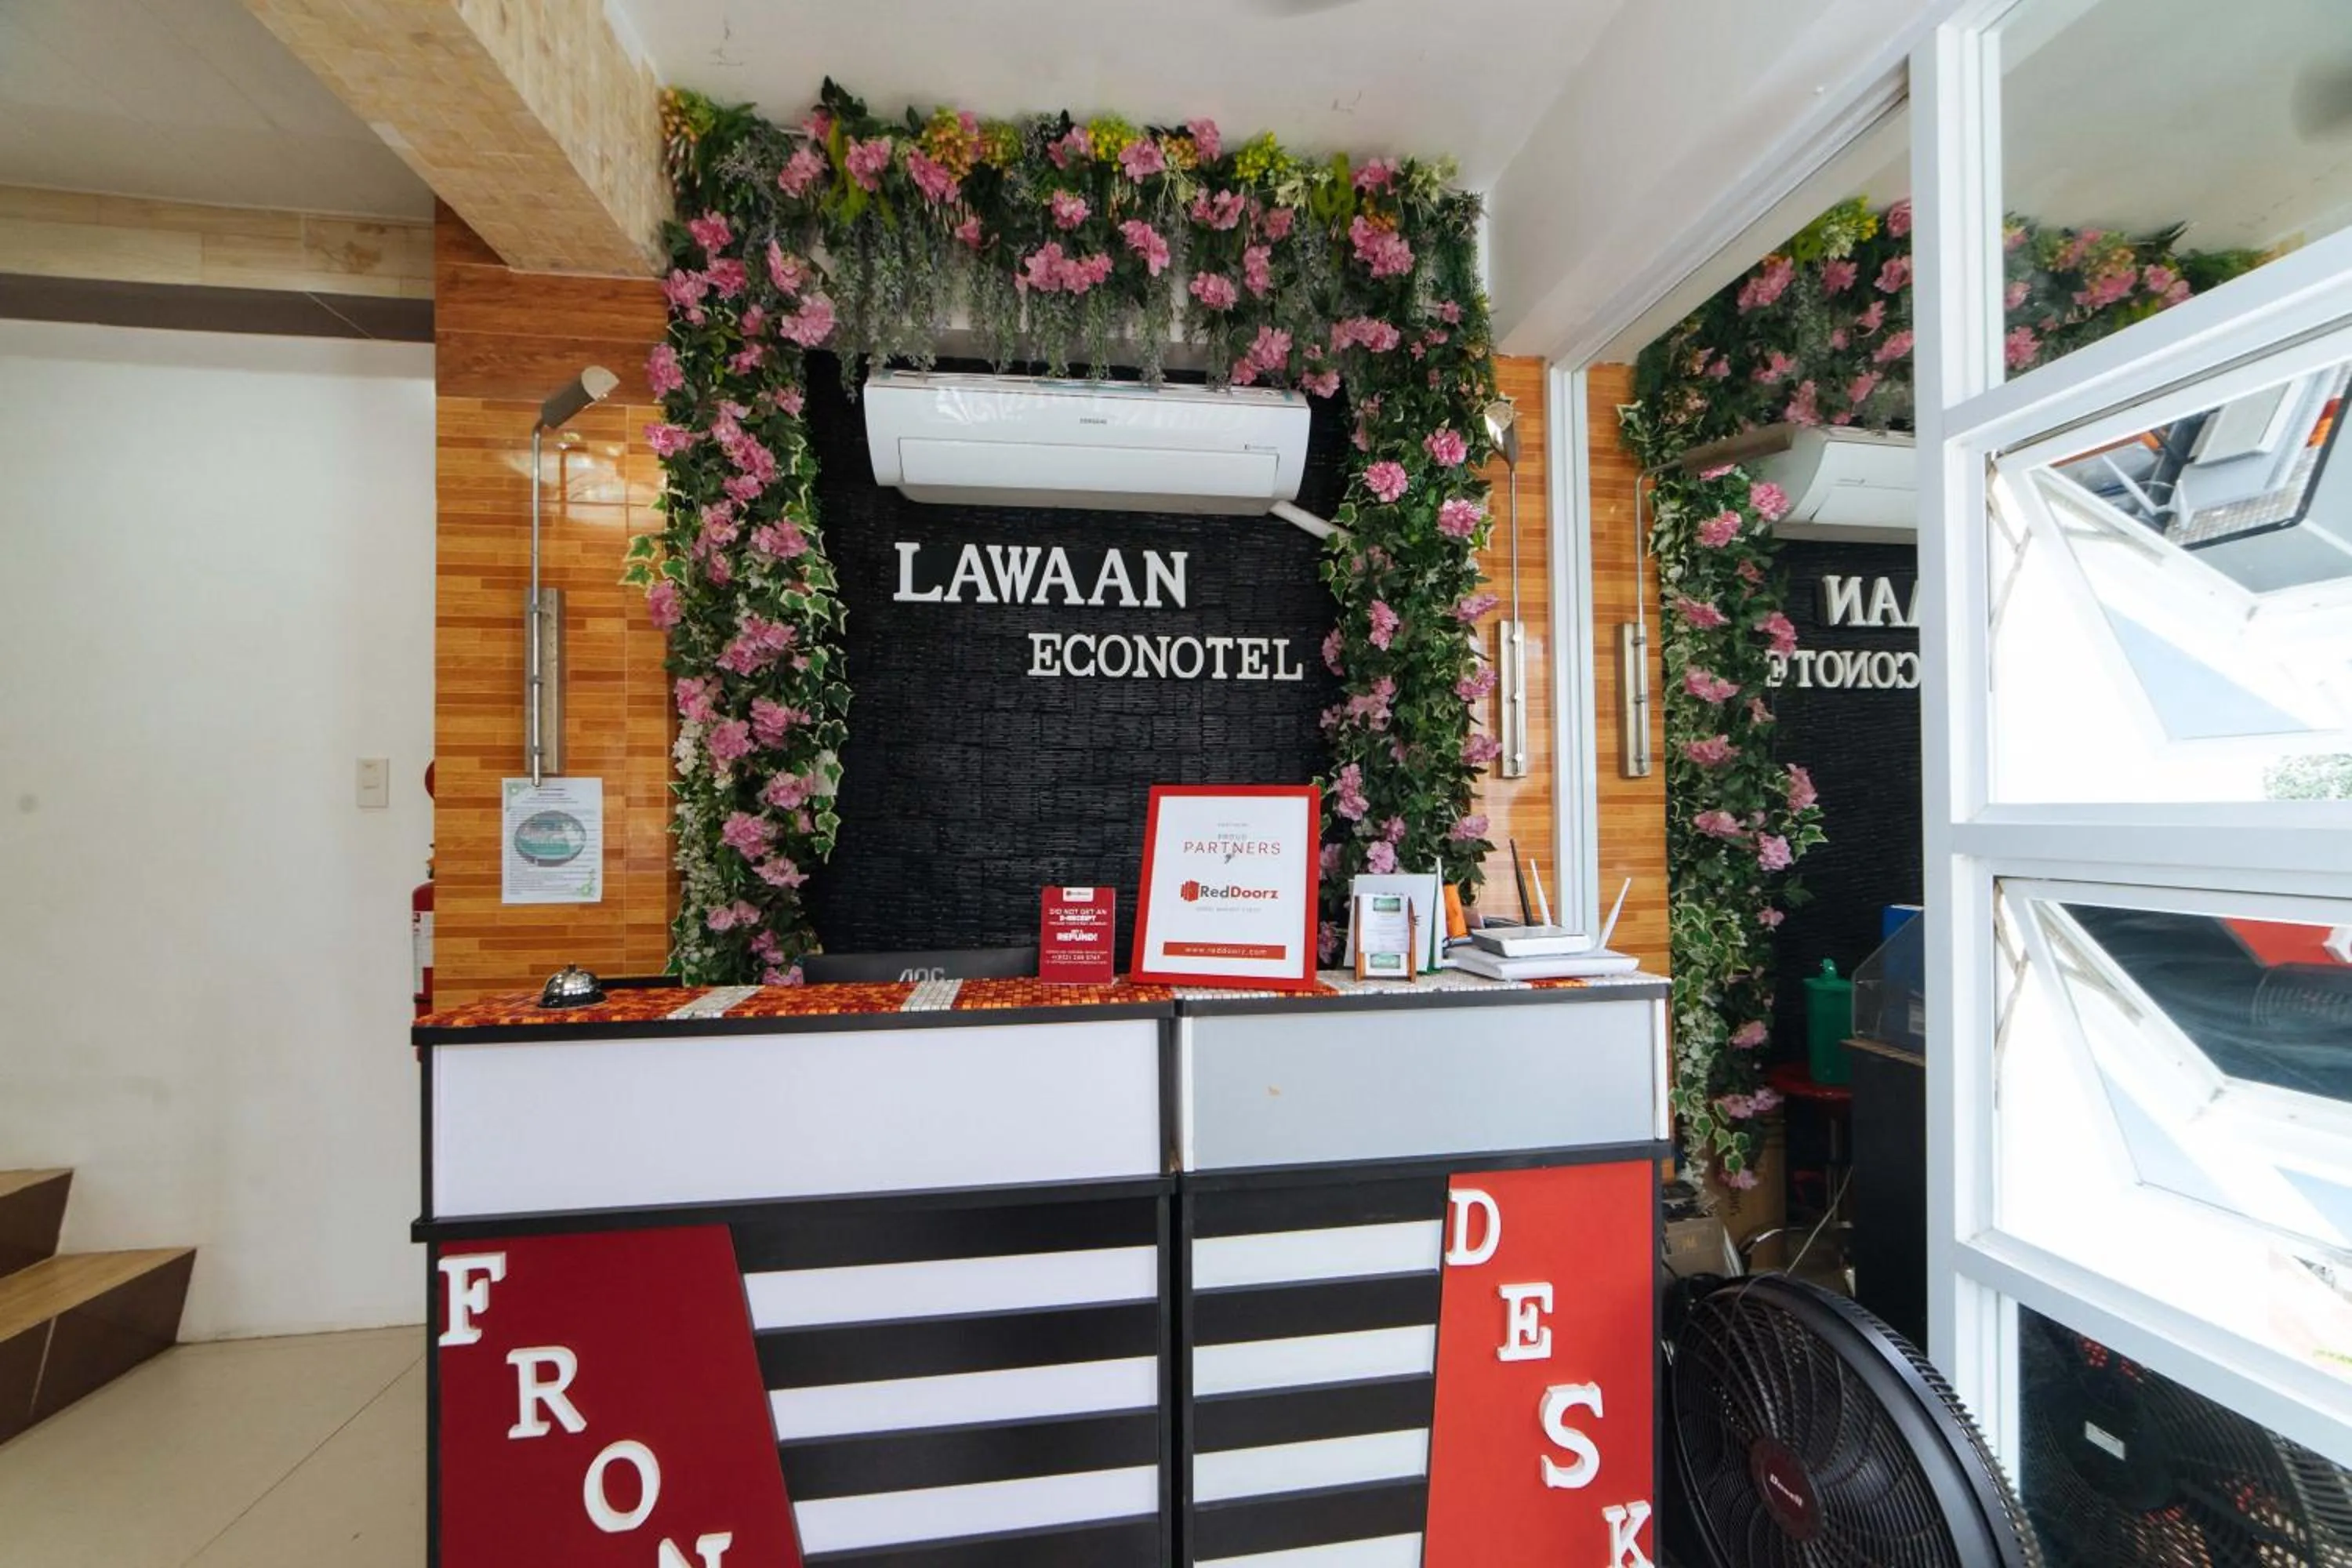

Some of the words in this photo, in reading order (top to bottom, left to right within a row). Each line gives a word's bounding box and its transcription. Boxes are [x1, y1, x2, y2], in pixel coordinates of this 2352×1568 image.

[893, 542, 1189, 608] LAWAAN
[1027, 632, 1303, 681] ECONOTEL
[1183, 841, 1280, 855] PARTNERS
[1200, 885, 1278, 899] RedDoorz
